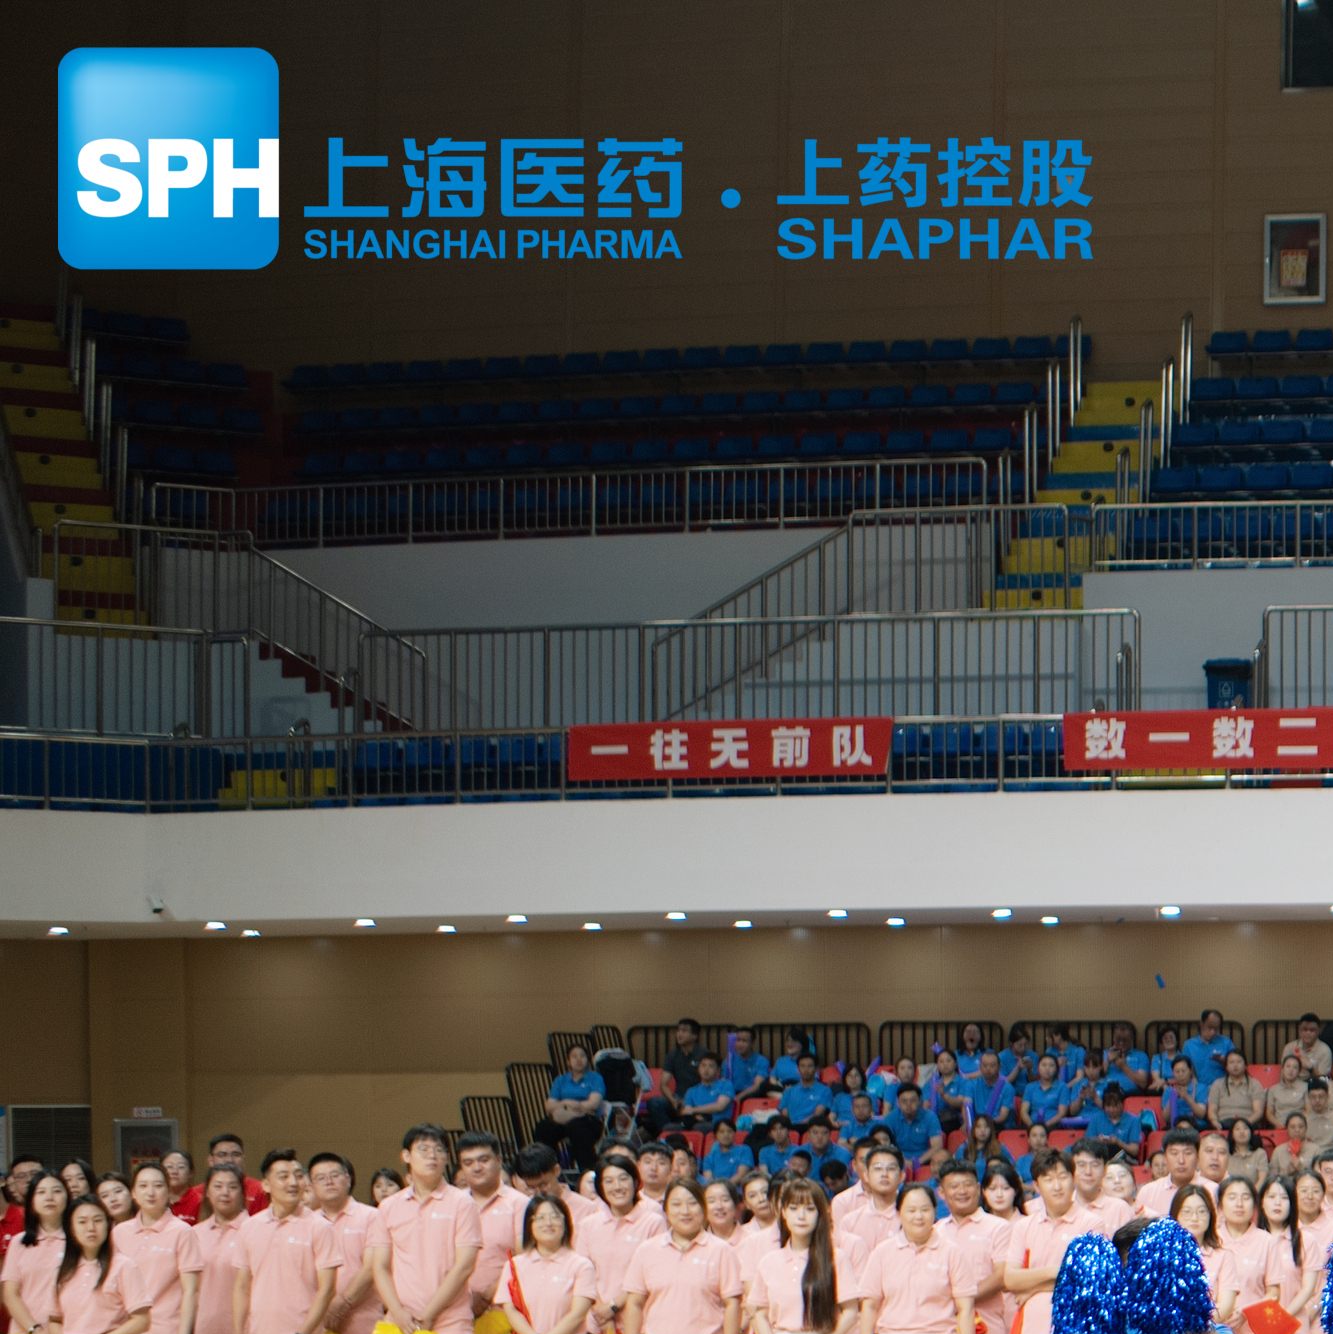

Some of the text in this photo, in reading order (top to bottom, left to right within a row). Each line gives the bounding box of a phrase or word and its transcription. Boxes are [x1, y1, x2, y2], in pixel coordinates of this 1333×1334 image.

[590, 725, 873, 771] 一往无前队
